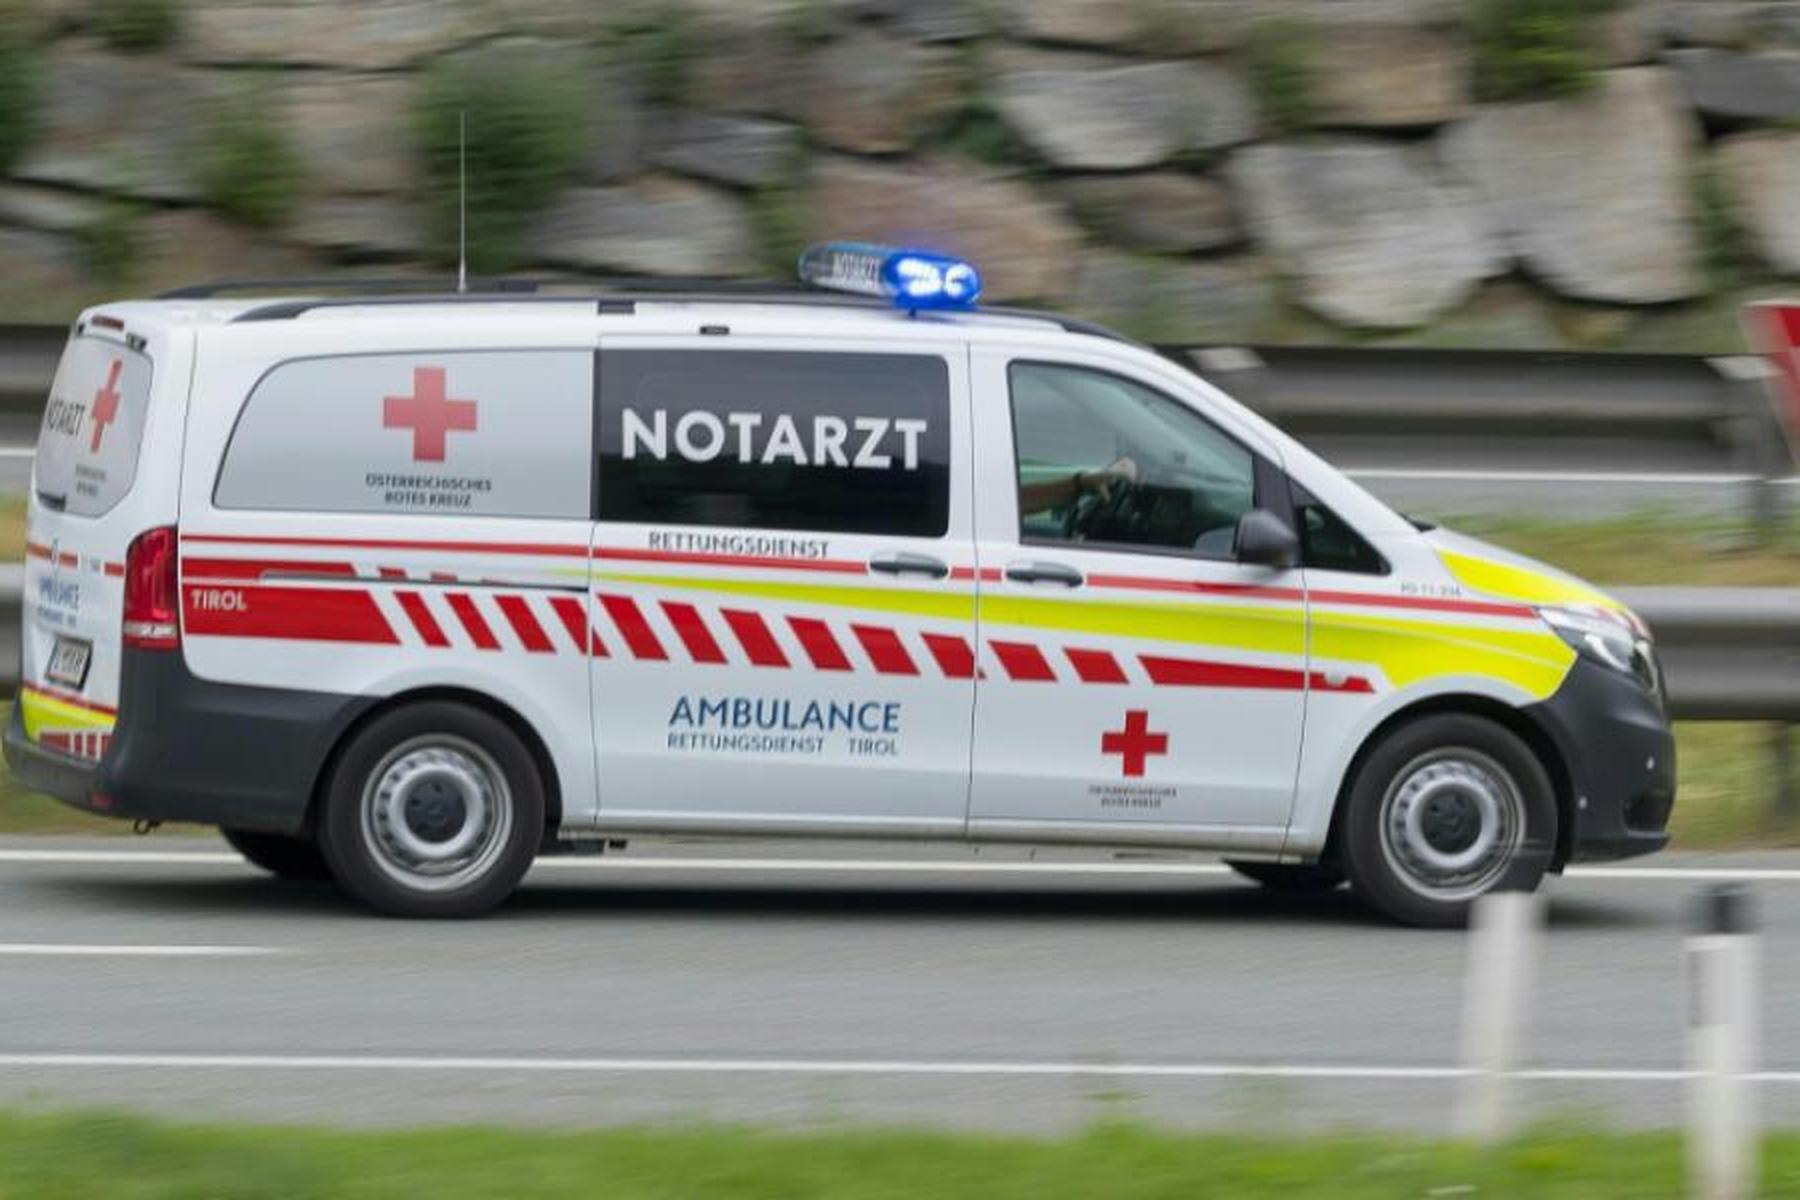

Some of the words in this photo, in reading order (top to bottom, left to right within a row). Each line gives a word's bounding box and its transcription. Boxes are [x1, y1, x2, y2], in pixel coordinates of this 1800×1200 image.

[621, 407, 928, 471] NOTARZT
[429, 492, 472, 508] KREUZ
[648, 530, 830, 560] RETTUNGSDIENST
[191, 588, 248, 612] TIROL
[668, 695, 902, 734] AMBULANCE
[667, 732, 825, 754] RETTUNGSDIENST
[849, 736, 899, 757] TIROL
